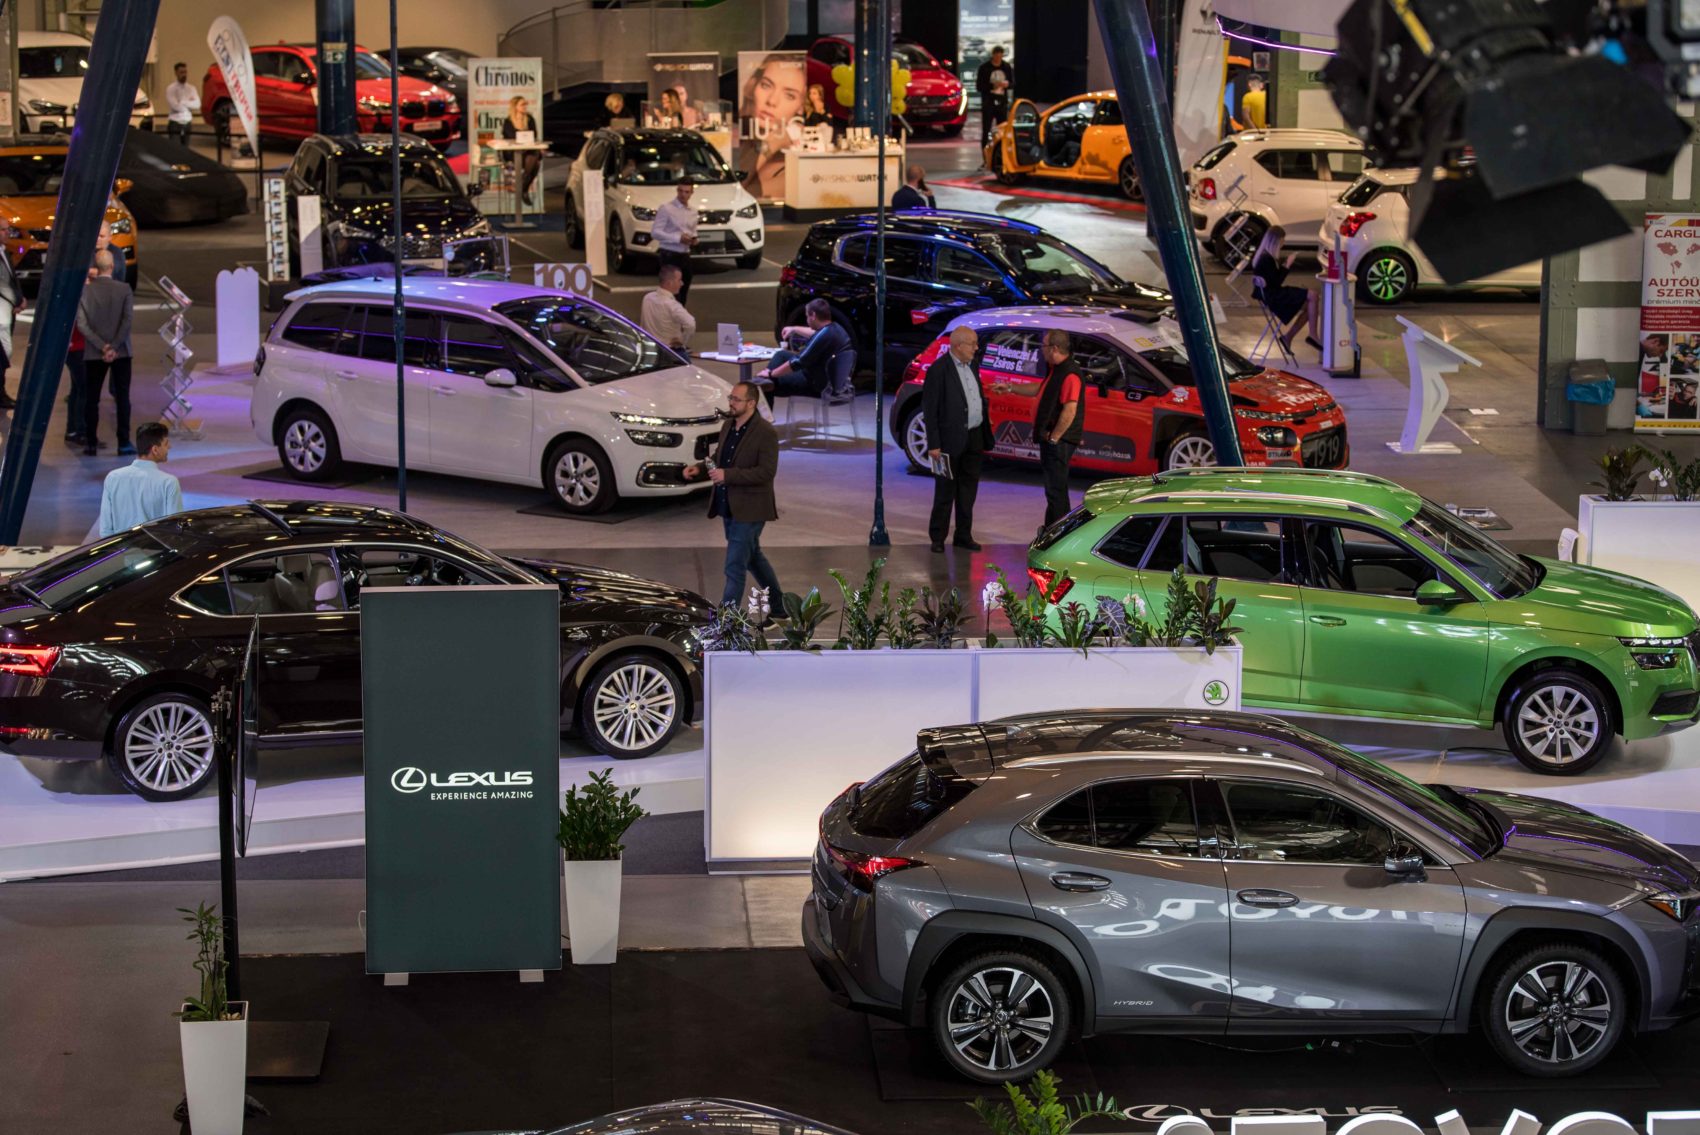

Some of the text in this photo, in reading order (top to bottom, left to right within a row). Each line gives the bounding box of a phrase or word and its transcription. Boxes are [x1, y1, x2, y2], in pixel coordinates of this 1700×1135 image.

[475, 66, 536, 87] Chronos
[536, 263, 592, 297] 100
[1127, 391, 1142, 400] C3
[1312, 434, 1340, 467] 1919
[430, 771, 534, 787] LEXUS
[431, 791, 534, 800] EXPERIENCE AMAZING
